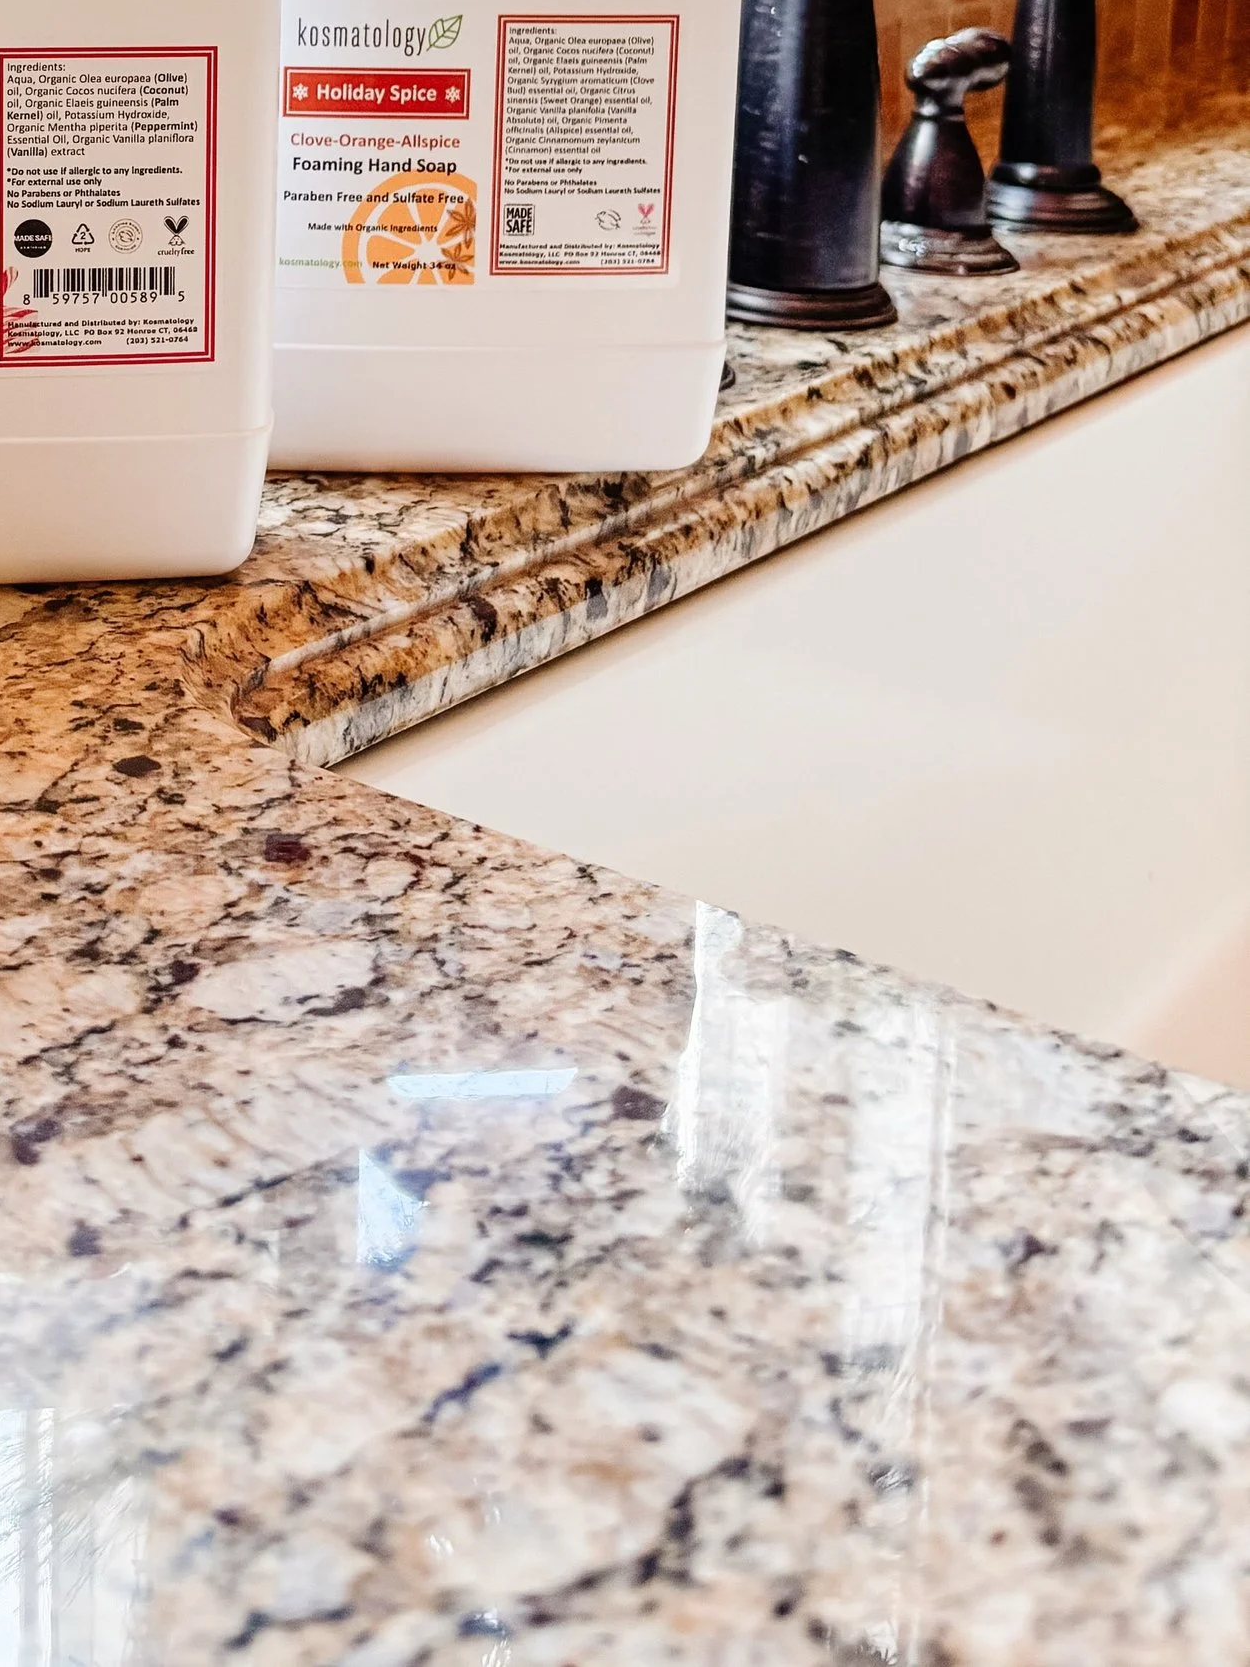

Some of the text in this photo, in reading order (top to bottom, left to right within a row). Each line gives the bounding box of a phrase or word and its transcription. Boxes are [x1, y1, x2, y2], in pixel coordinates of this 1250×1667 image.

[298, 18, 426, 57] kosmatology
[7, 63, 65, 74] Ingredients:
[7, 74, 187, 86] Aqua, Organic Olea europaea (Olive)
[7, 86, 188, 98] oil, Organic Cocos nucifera (Coconut)
[317, 84, 436, 103] Holiday Spice
[7, 98, 178, 110] oil, Organic Elaeis guineensis (Palm
[7, 110, 169, 122] Kernel) oil, Potassium Hydroxide,
[7, 122, 198, 134] Organic Mentha piperita (Peppermint)
[7, 135, 49, 144] Essential
[53, 135, 69, 145] Oil,
[72, 135, 110, 146] Organic
[113, 134, 145, 143] Vanilla
[291, 133, 460, 151] Clove-Orange-Allspice
[7, 147, 85, 159] (Vanilla) extract
[293, 157, 457, 175] Foaming Hand Soap
[284, 191, 464, 203] Paraben Free and Sulfate Free
[507, 208, 532, 218] MADE
[356, 224, 388, 232] Organic
[390, 225, 437, 233] Ingredients
[506, 220, 532, 233] SAFE
[393, 261, 426, 270] Weight
[23, 291, 184, 305] 8 59757 00589 5
